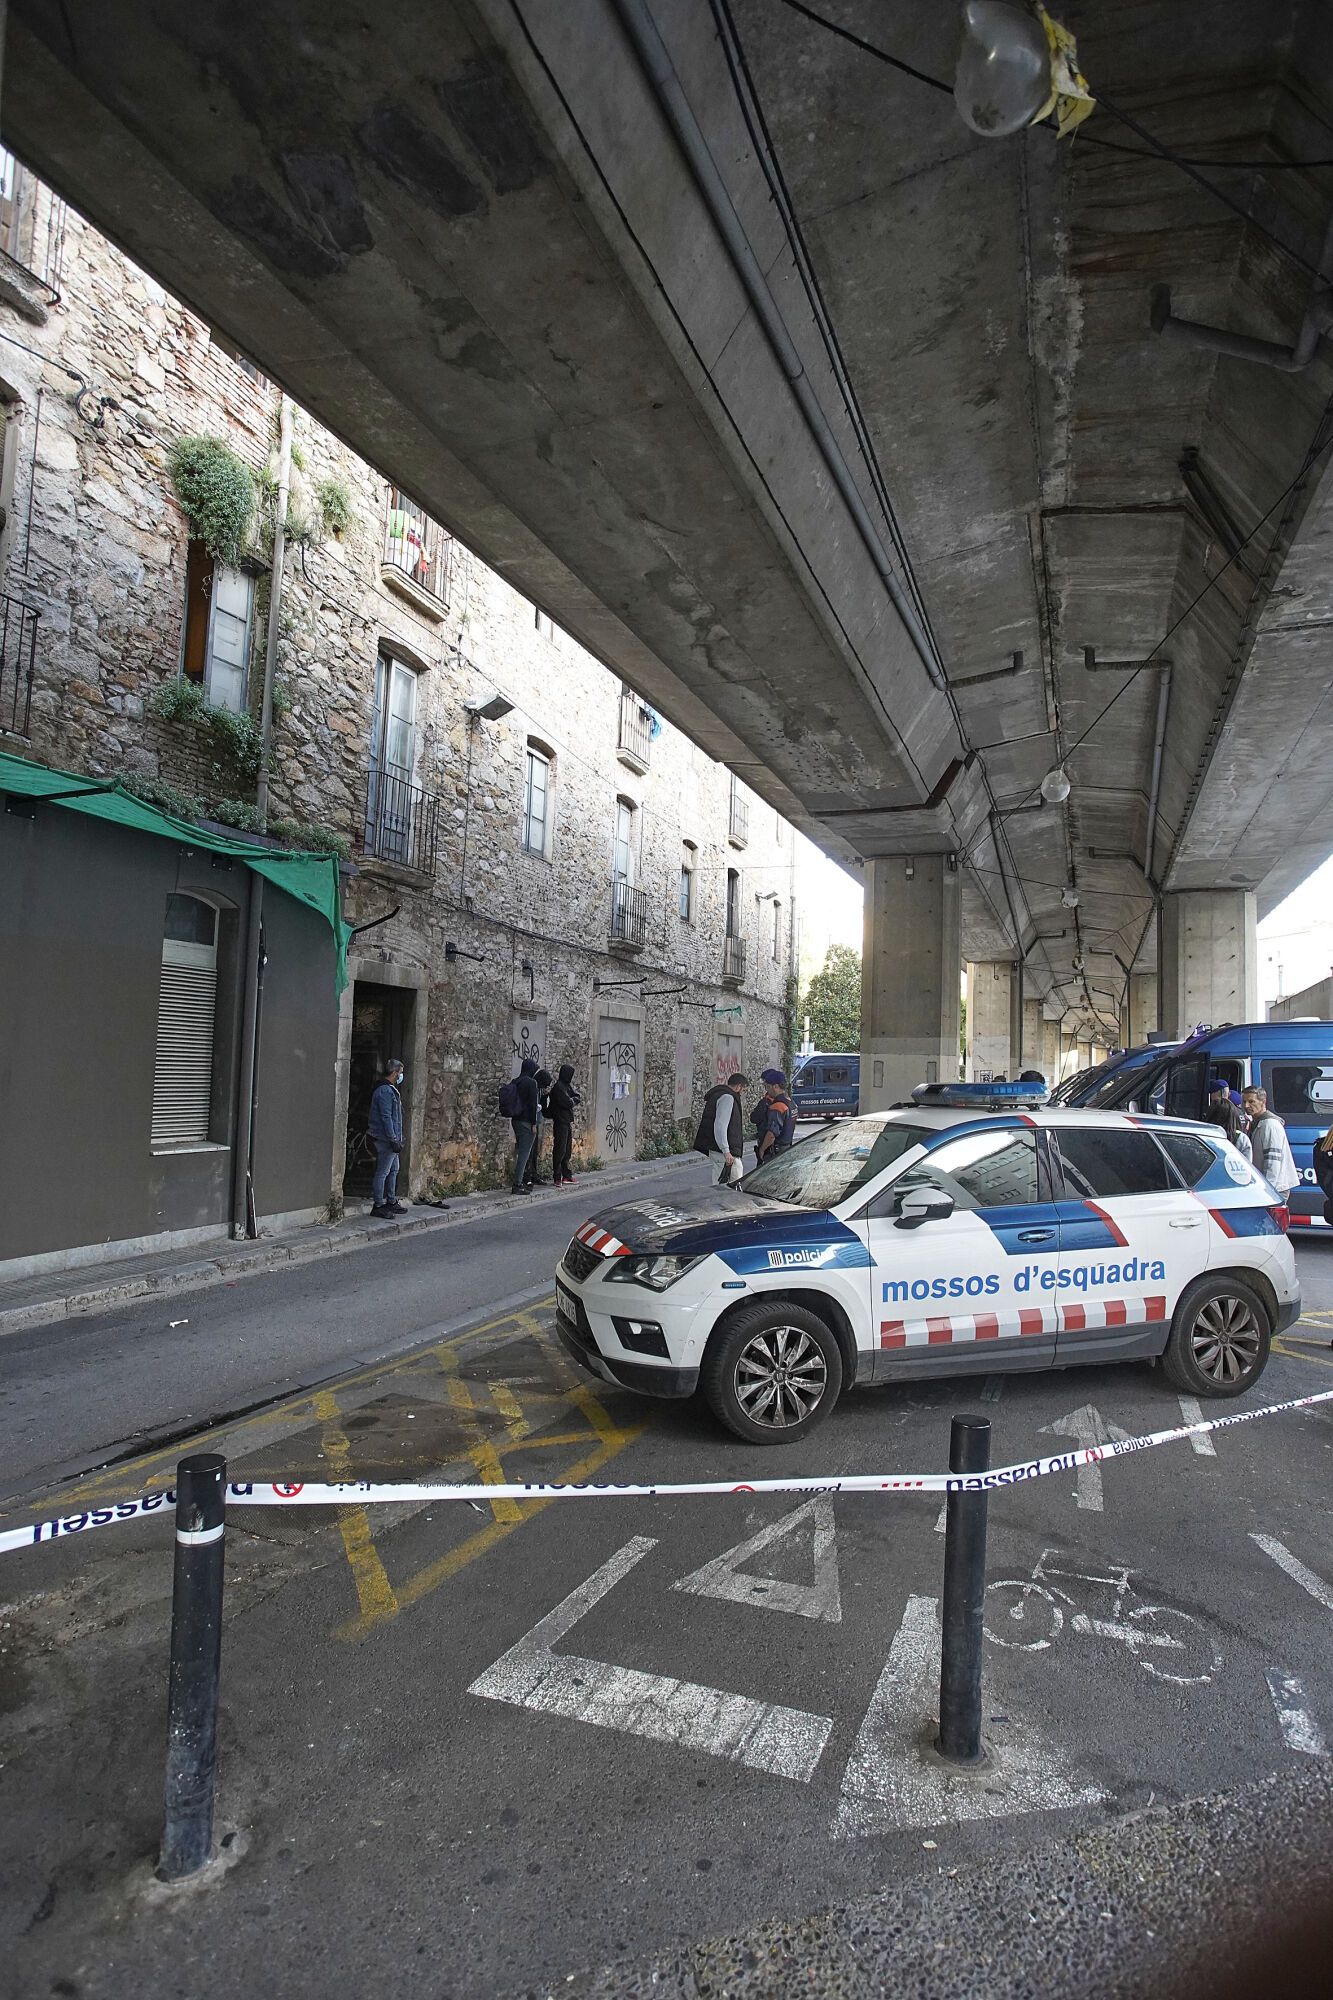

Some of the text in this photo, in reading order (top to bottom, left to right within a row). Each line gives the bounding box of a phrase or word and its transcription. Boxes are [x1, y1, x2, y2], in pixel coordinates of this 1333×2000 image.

[784, 1248, 824, 1265] polici
[882, 1256, 1166, 1303] mossos d'esquadra
[1048, 1454, 1077, 1473] no
